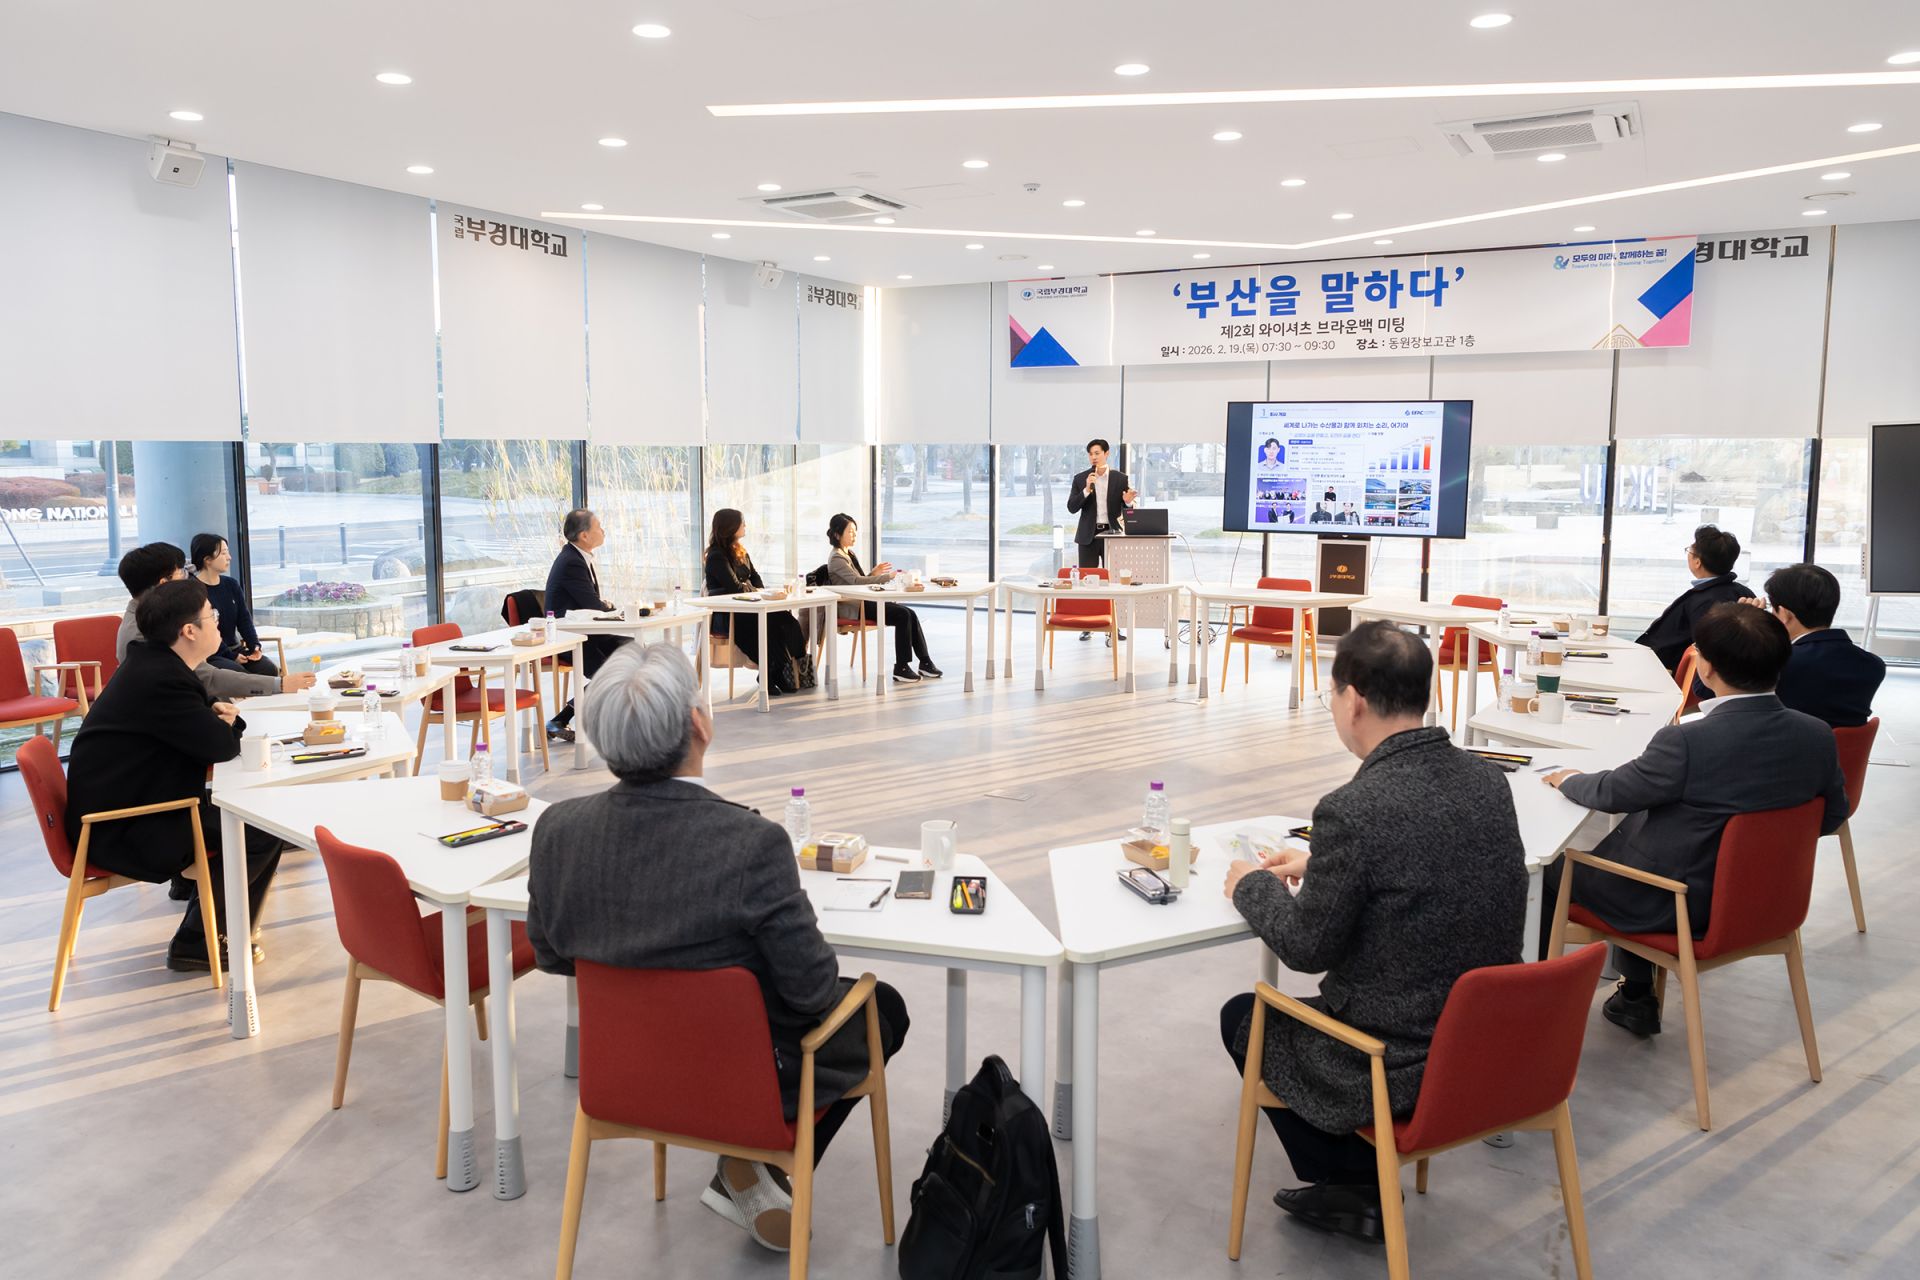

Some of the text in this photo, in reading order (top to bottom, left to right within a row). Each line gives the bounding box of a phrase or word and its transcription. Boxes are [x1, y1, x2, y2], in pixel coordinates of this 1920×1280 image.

[467, 217, 568, 257] 부경대학교
[1619, 250, 1654, 260] 함께하는
[1696, 236, 1809, 263] 경대학교
[1220, 317, 1405, 339] 제2회 와이셔츠 브라운백 미팅
[1188, 345, 1215, 355] 2026.
[1262, 341, 1291, 353] 07:30
[1304, 339, 1335, 351] 09:30
[1356, 338, 1378, 351] 장소
[1388, 335, 1456, 350] 동원장보고관
[1460, 334, 1475, 348] 1층
[47, 505, 130, 520] NATIONL
